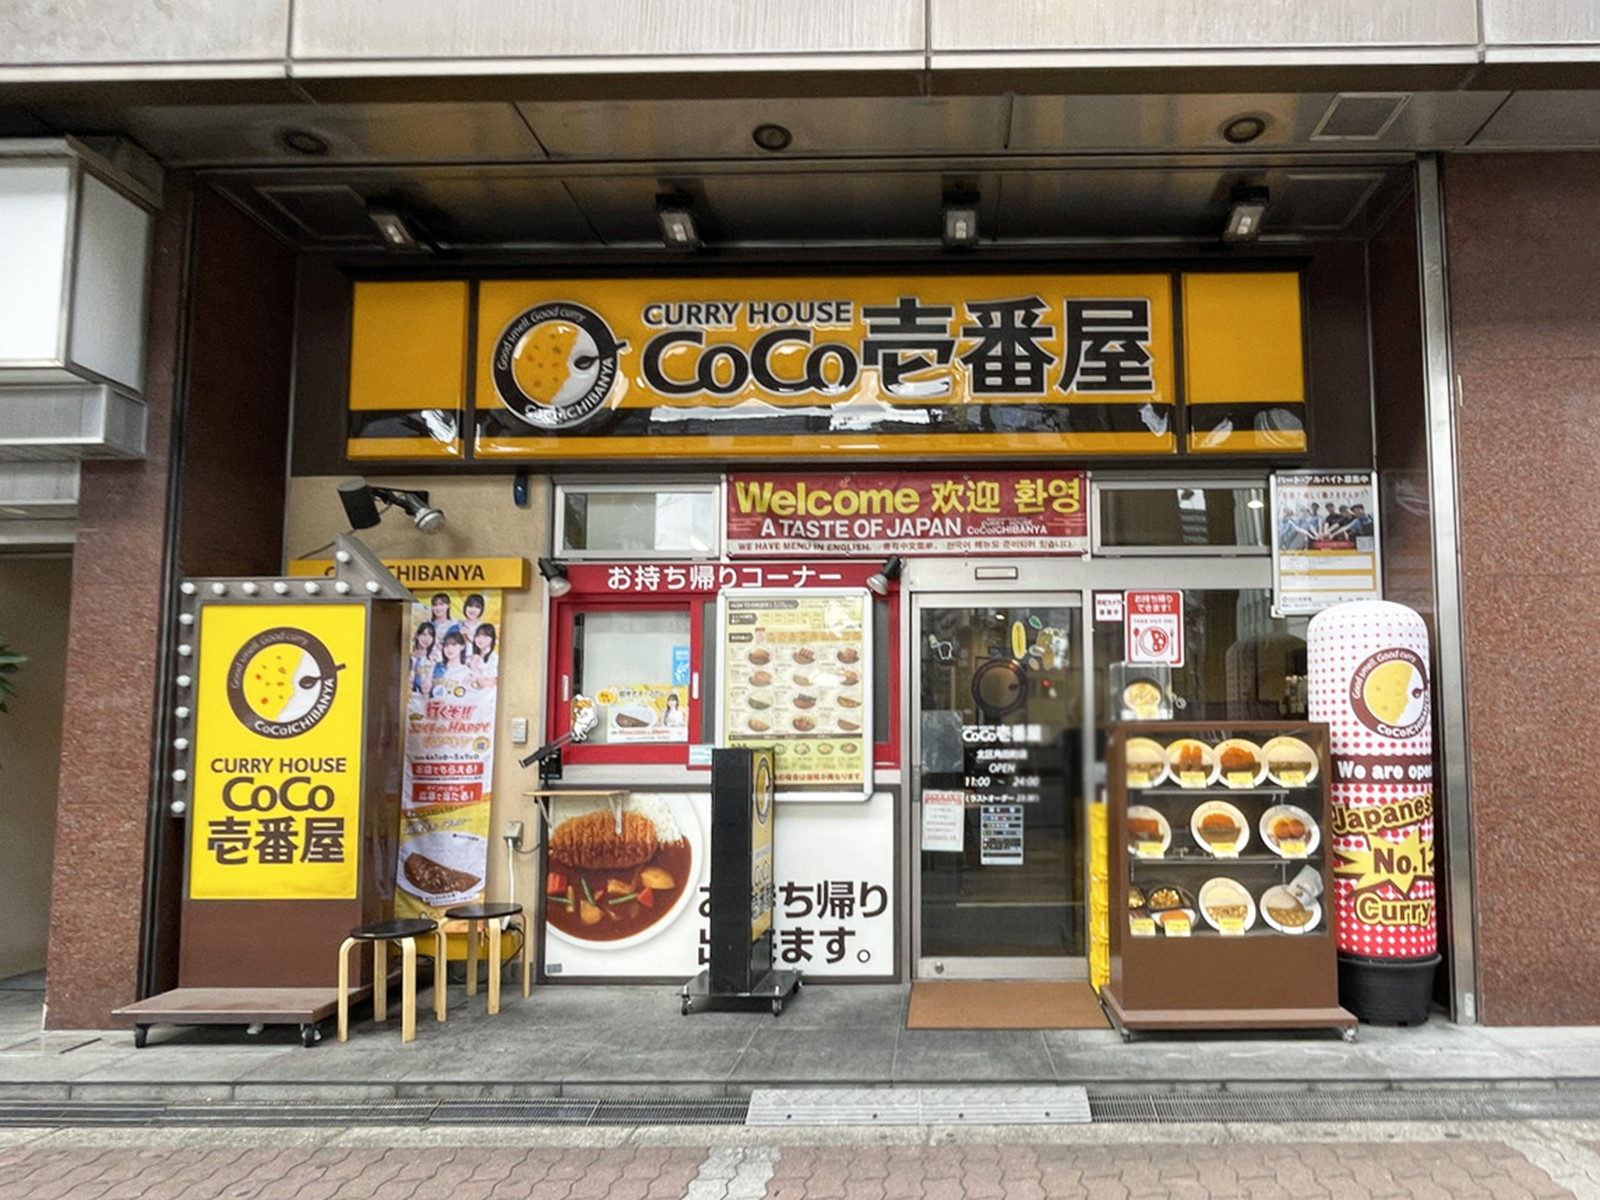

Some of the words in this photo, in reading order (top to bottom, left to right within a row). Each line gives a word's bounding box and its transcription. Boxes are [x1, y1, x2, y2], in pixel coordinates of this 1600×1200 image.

[530, 306, 559, 322] Good
[642, 302, 740, 327] CURRY
[748, 301, 853, 324] HOUSE
[641, 297, 1156, 397] CoCo壱番屋
[734, 480, 920, 516] Welcome
[931, 479, 1001, 514] 欢迎
[1014, 477, 1081, 514] 환영
[760, 518, 776, 538] A
[779, 519, 849, 539] TASTE
[853, 518, 882, 538] OF
[886, 517, 961, 538] JAPAN
[755, 542, 780, 550] HAVE
[783, 542, 811, 550] MENU
[607, 565, 843, 591] お持ち帰りコーナー
[254, 678, 335, 736] CoCoICHIBANYA
[210, 758, 273, 773] CURRY
[279, 757, 346, 773] HOUSE
[988, 763, 1016, 774] OPEN
[1337, 760, 1366, 780] We
[1372, 764, 1404, 780] are
[222, 776, 335, 812] CoCo
[964, 776, 991, 787] 11:00
[1333, 794, 1433, 836] Japanes
[207, 816, 345, 865] 壱番屋
[1373, 848, 1427, 876] No.1
[698, 880, 889, 920] ち帰り
[1357, 894, 1432, 925] Curry
[698, 926, 871, 966] ます。
